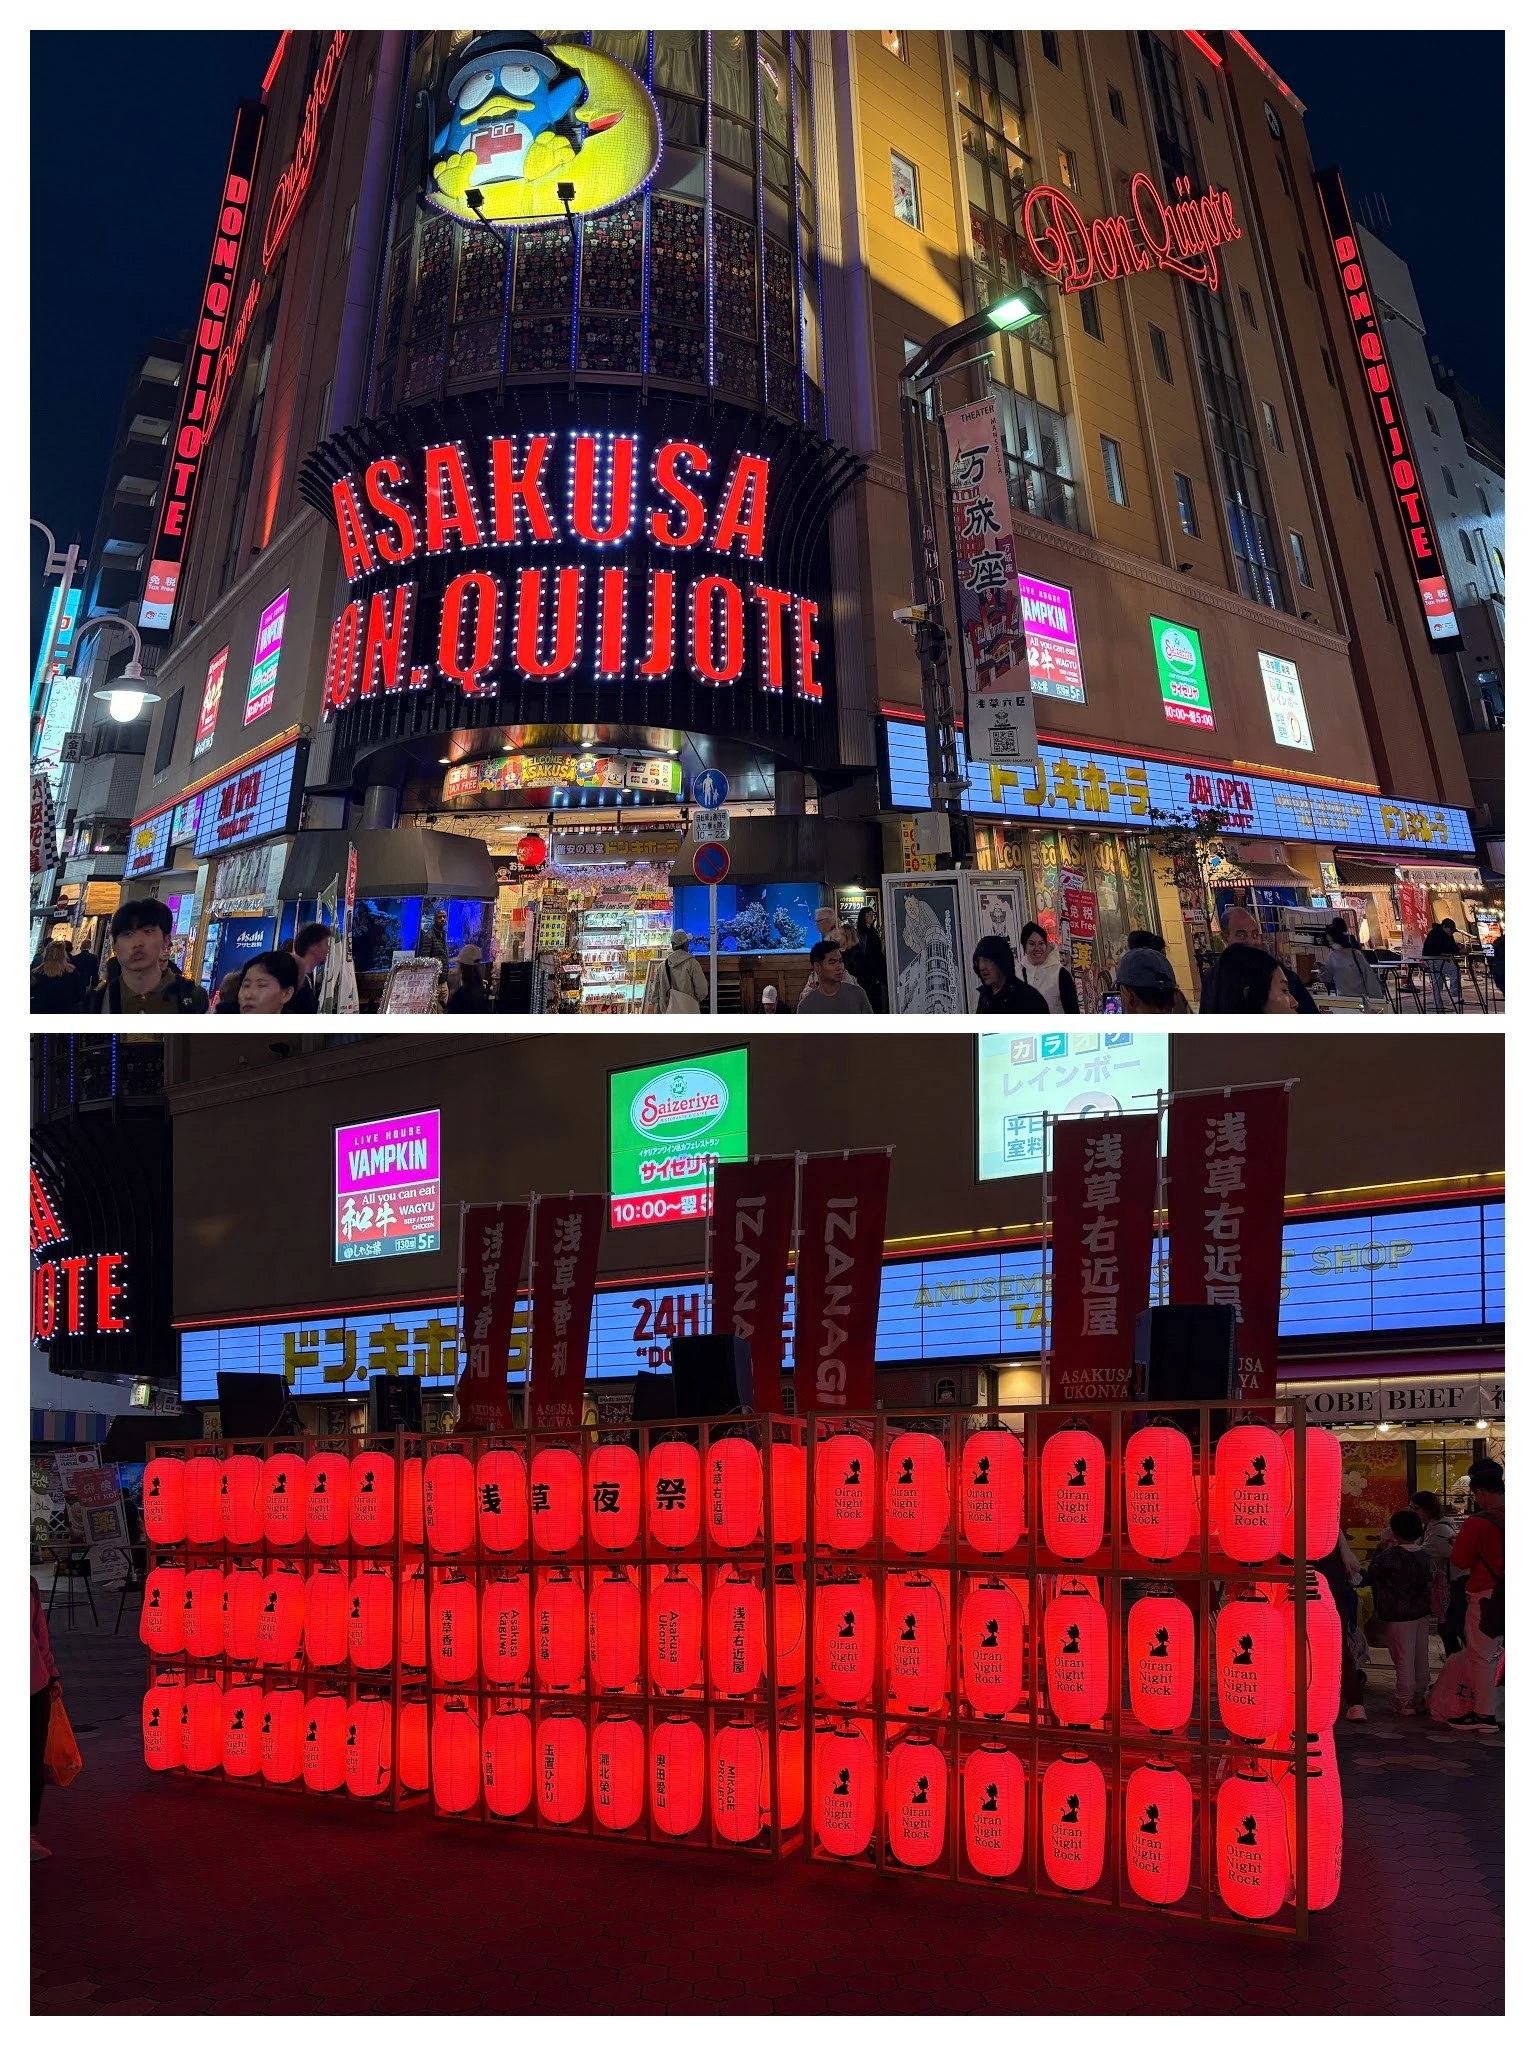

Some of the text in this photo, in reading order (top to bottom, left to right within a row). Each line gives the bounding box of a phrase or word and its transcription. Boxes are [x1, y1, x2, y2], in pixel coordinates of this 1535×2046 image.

[960, 405, 995, 424] THEATER
[331, 433, 773, 582] ASAKUSA
[960, 445, 1008, 593] 万成座
[1029, 636, 1076, 656] All you can eat
[1055, 656, 1078, 669] WAGYU
[1070, 685, 1081, 700] 5F
[523, 754, 564, 769] WELCOME
[521, 764, 578, 783] ASAKUSA
[449, 780, 477, 794] TAX FREE
[1185, 772, 1214, 806] 24H
[1216, 777, 1254, 811] OPEN
[1040, 842, 1058, 869] to
[1070, 904, 1095, 922] 免税
[1079, 920, 1097, 932] Free
[236, 930, 265, 942] Asahi
[1072, 941, 1093, 972] 薬
[1003, 1054, 1141, 1097] レインボー
[639, 1092, 719, 1128] Saizeriya
[354, 1126, 421, 1146] LIVE HOUSE
[348, 1137, 428, 1182] VAMPKIN
[361, 1185, 436, 1206] All you can eat
[399, 1201, 435, 1216] WAGYU
[340, 1197, 398, 1241] 和牛
[403, 1214, 435, 1225] BEEF PORK
[411, 1222, 435, 1231] CHICKEN
[418, 1232, 435, 1250] 5F
[1080, 1133, 1124, 1337] 浅草右近屋
[1311, 1238, 1413, 1276] SHOP
[734, 1195, 767, 1341] IZANA
[550, 1213, 583, 1379] 浅草香和
[816, 1195, 858, 1405] IZANAGI
[632, 1291, 699, 1342] 24H
[1009, 1301, 1053, 1330] TA
[1060, 1367, 1134, 1386] ASAKUSA
[1063, 1384, 1129, 1400] UKONYA
[1293, 1391, 1373, 1413] KOBE
[1386, 1387, 1465, 1410] BEEF
[712, 1460, 724, 1526] 浅草右近屋
[835, 1488, 862, 1497] Oiran
[967, 1488, 992, 1498] Oiran
[1057, 1490, 1089, 1500] Oiran
[1234, 1490, 1269, 1501] Oiran
[835, 1499, 863, 1508] Night
[967, 1500, 993, 1511] Night
[1057, 1501, 1089, 1513] Night
[1233, 1503, 1269, 1515] Night
[836, 1510, 861, 1519] Rock
[966, 1512, 992, 1521] Rock
[1058, 1513, 1088, 1524] Rock
[1235, 1515, 1267, 1526] Rock
[441, 1609, 453, 1659] 浅草香和
[498, 1611, 509, 1657] Kaguwa
[510, 1609, 520, 1658] Asakusa
[658, 1614, 667, 1660] Ukonya
[669, 1610, 679, 1663] Asakusa
[732, 1606, 747, 1675] 浅草右近屋
[830, 1640, 857, 1650] Oiran
[830, 1651, 858, 1662] Night
[1054, 1656, 1084, 1667] Oiran
[831, 1662, 856, 1672] Rock
[1224, 1667, 1257, 1679] Oiran
[1055, 1669, 1085, 1681] Night
[1057, 1681, 1084, 1691] Rock
[1224, 1680, 1257, 1694] Night
[1226, 1693, 1256, 1705] Rock
[225, 1741, 247, 1749] Night
[544, 1744, 555, 1803] 玉置ひかり
[716, 1759, 727, 1814] PROJECT
[726, 1766, 736, 1811] MIKAGE
[825, 1797, 852, 1808] Oiran
[824, 1809, 852, 1819] Night
[974, 1813, 1001, 1825] Oiran
[826, 1819, 850, 1830] Rock
[974, 1826, 1002, 1838] Night
[975, 1837, 1001, 1849] Rock
[1132, 1833, 1161, 1848] Oiran
[1133, 1847, 1162, 1862] Night
[1227, 1845, 1261, 1859] Oiran
[1132, 1860, 1161, 1873] Rock
[1227, 1858, 1262, 1875] Night
[1229, 1873, 1260, 1886] Rock
